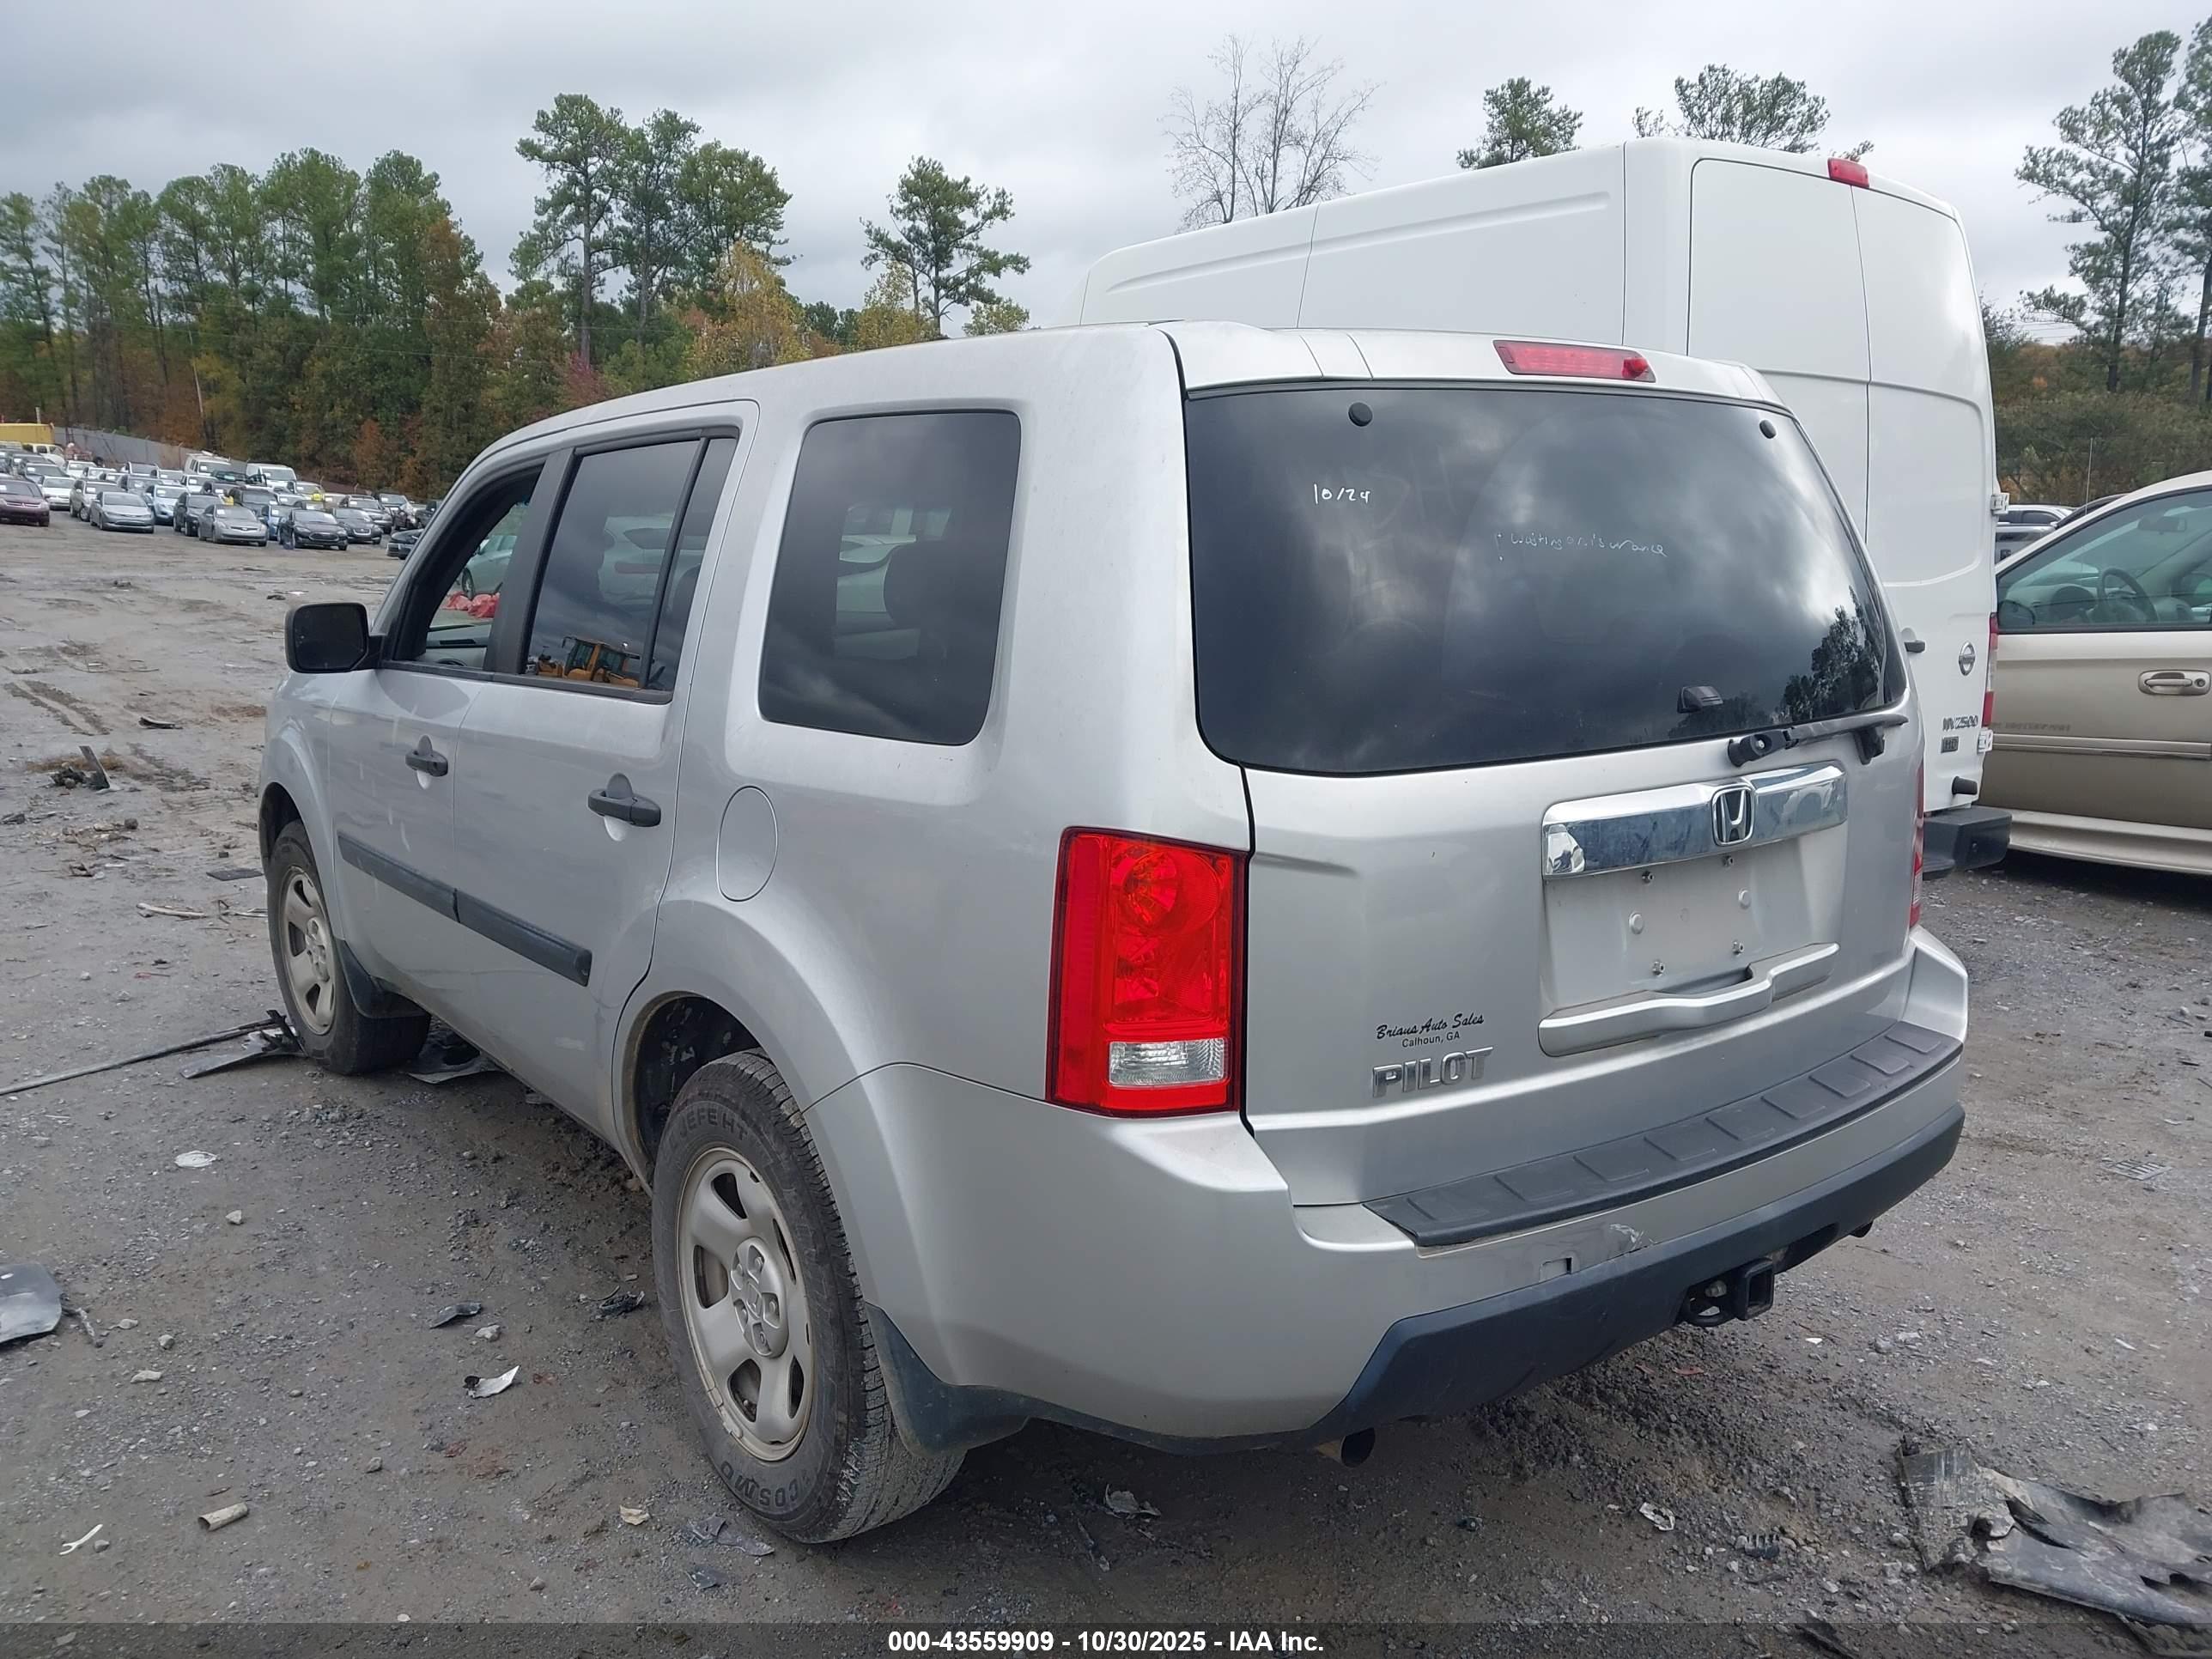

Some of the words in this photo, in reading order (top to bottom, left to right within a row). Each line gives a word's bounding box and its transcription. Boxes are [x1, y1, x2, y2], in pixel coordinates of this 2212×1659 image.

[1417, 1017, 1448, 1034] Auto
[1451, 1012, 1485, 1029] Sales
[1401, 1035, 1444, 1048] Calhoun,
[1446, 1031, 1461, 1042] GA
[1372, 1045, 1494, 1098] PILOT
